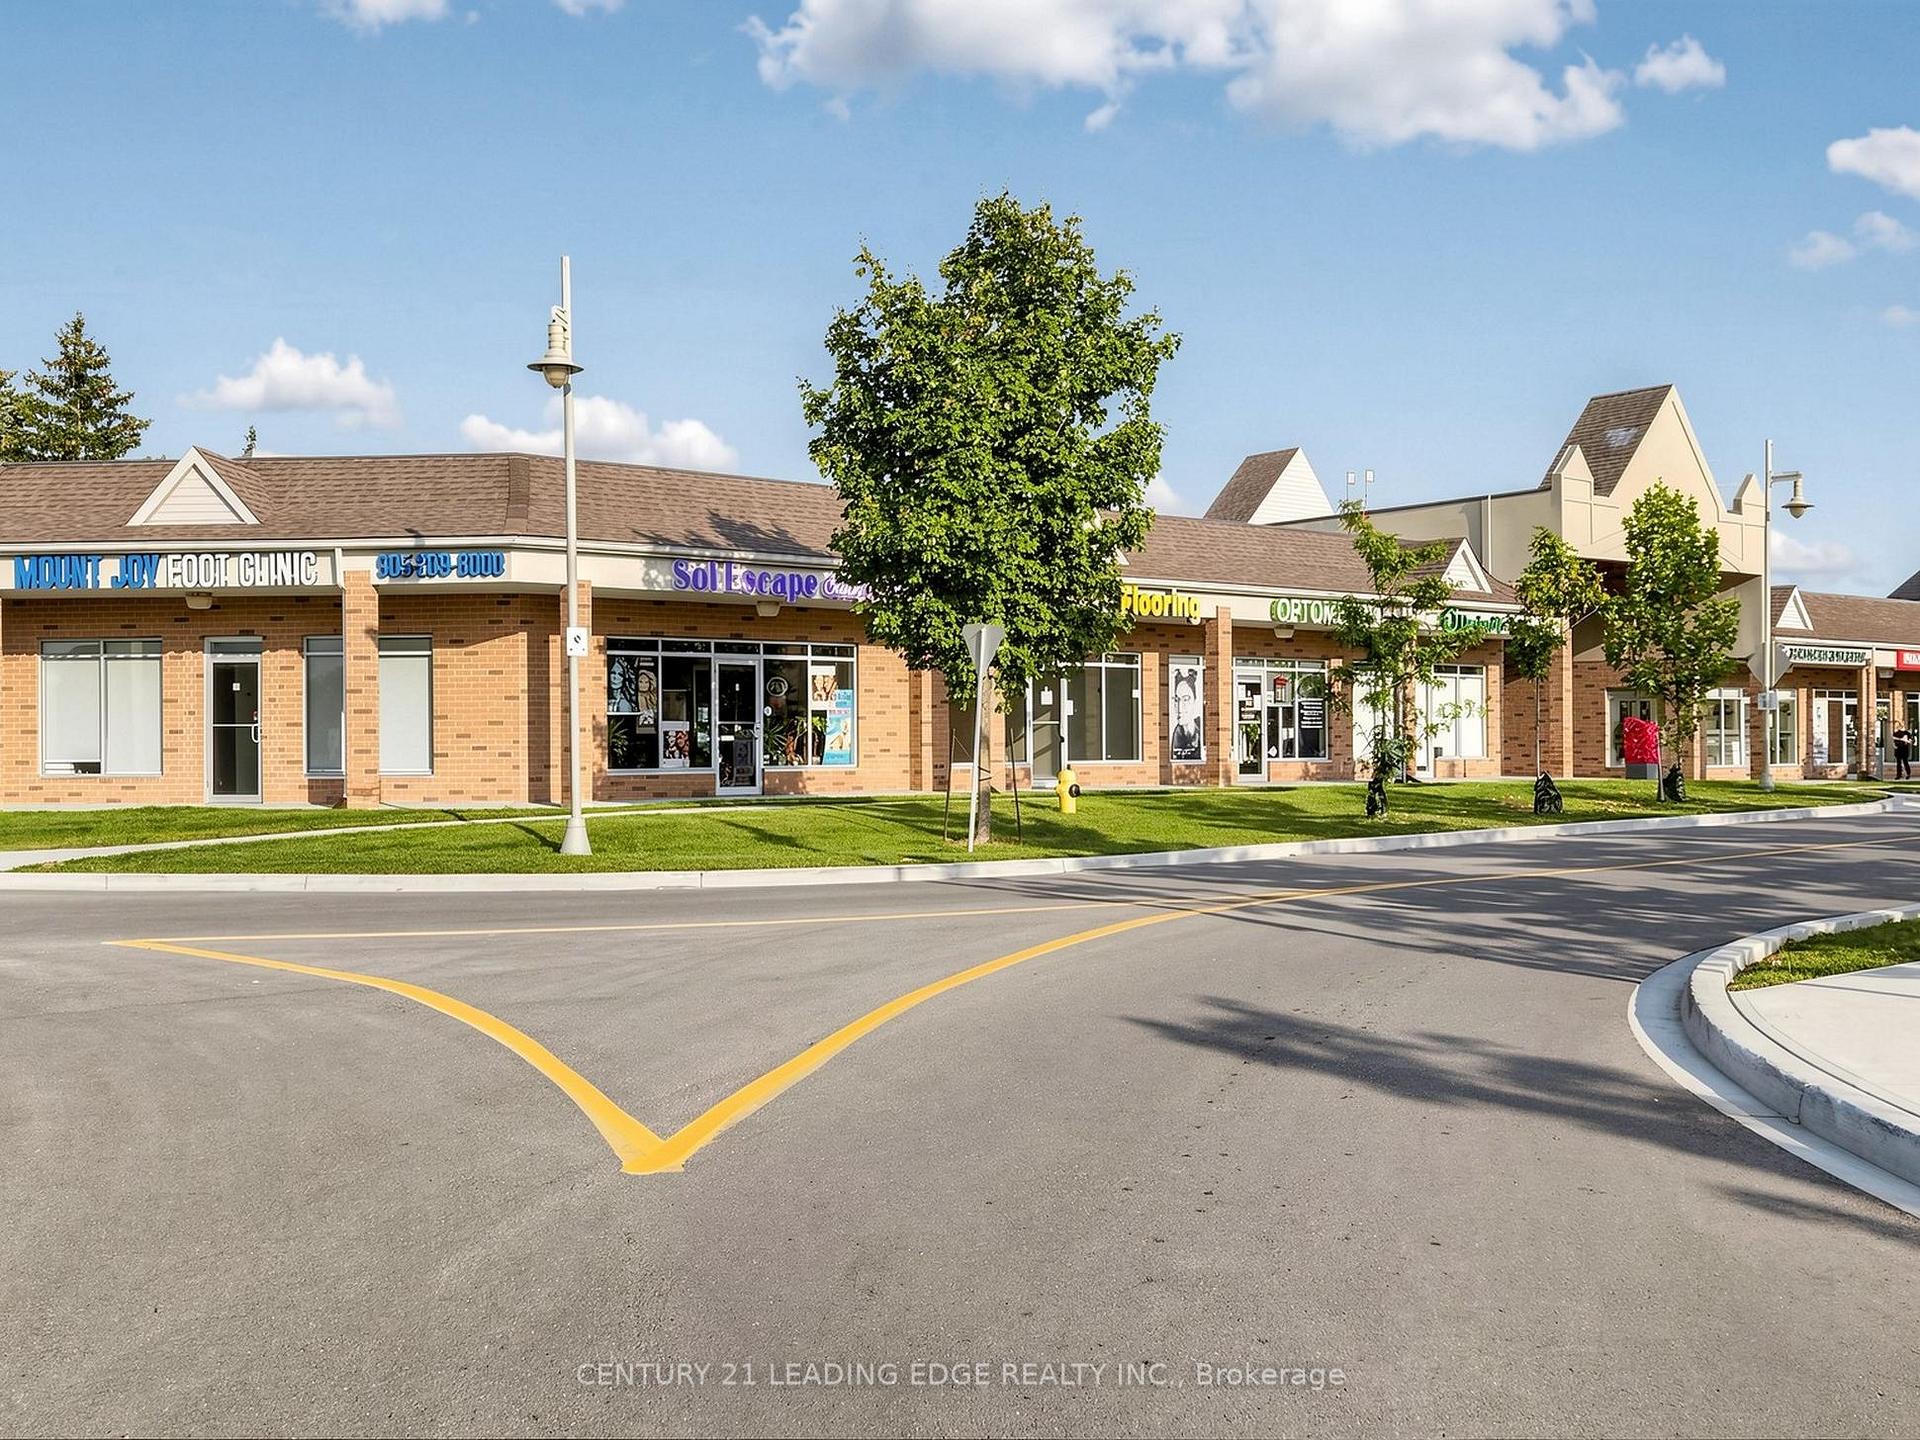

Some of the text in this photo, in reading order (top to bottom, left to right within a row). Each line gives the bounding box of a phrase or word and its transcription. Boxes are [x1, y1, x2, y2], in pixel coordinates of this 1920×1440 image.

[13, 551, 318, 590] MOUNT JOY FOOT CLINIC
[672, 558, 717, 592] Sol
[723, 560, 818, 604] Escape
